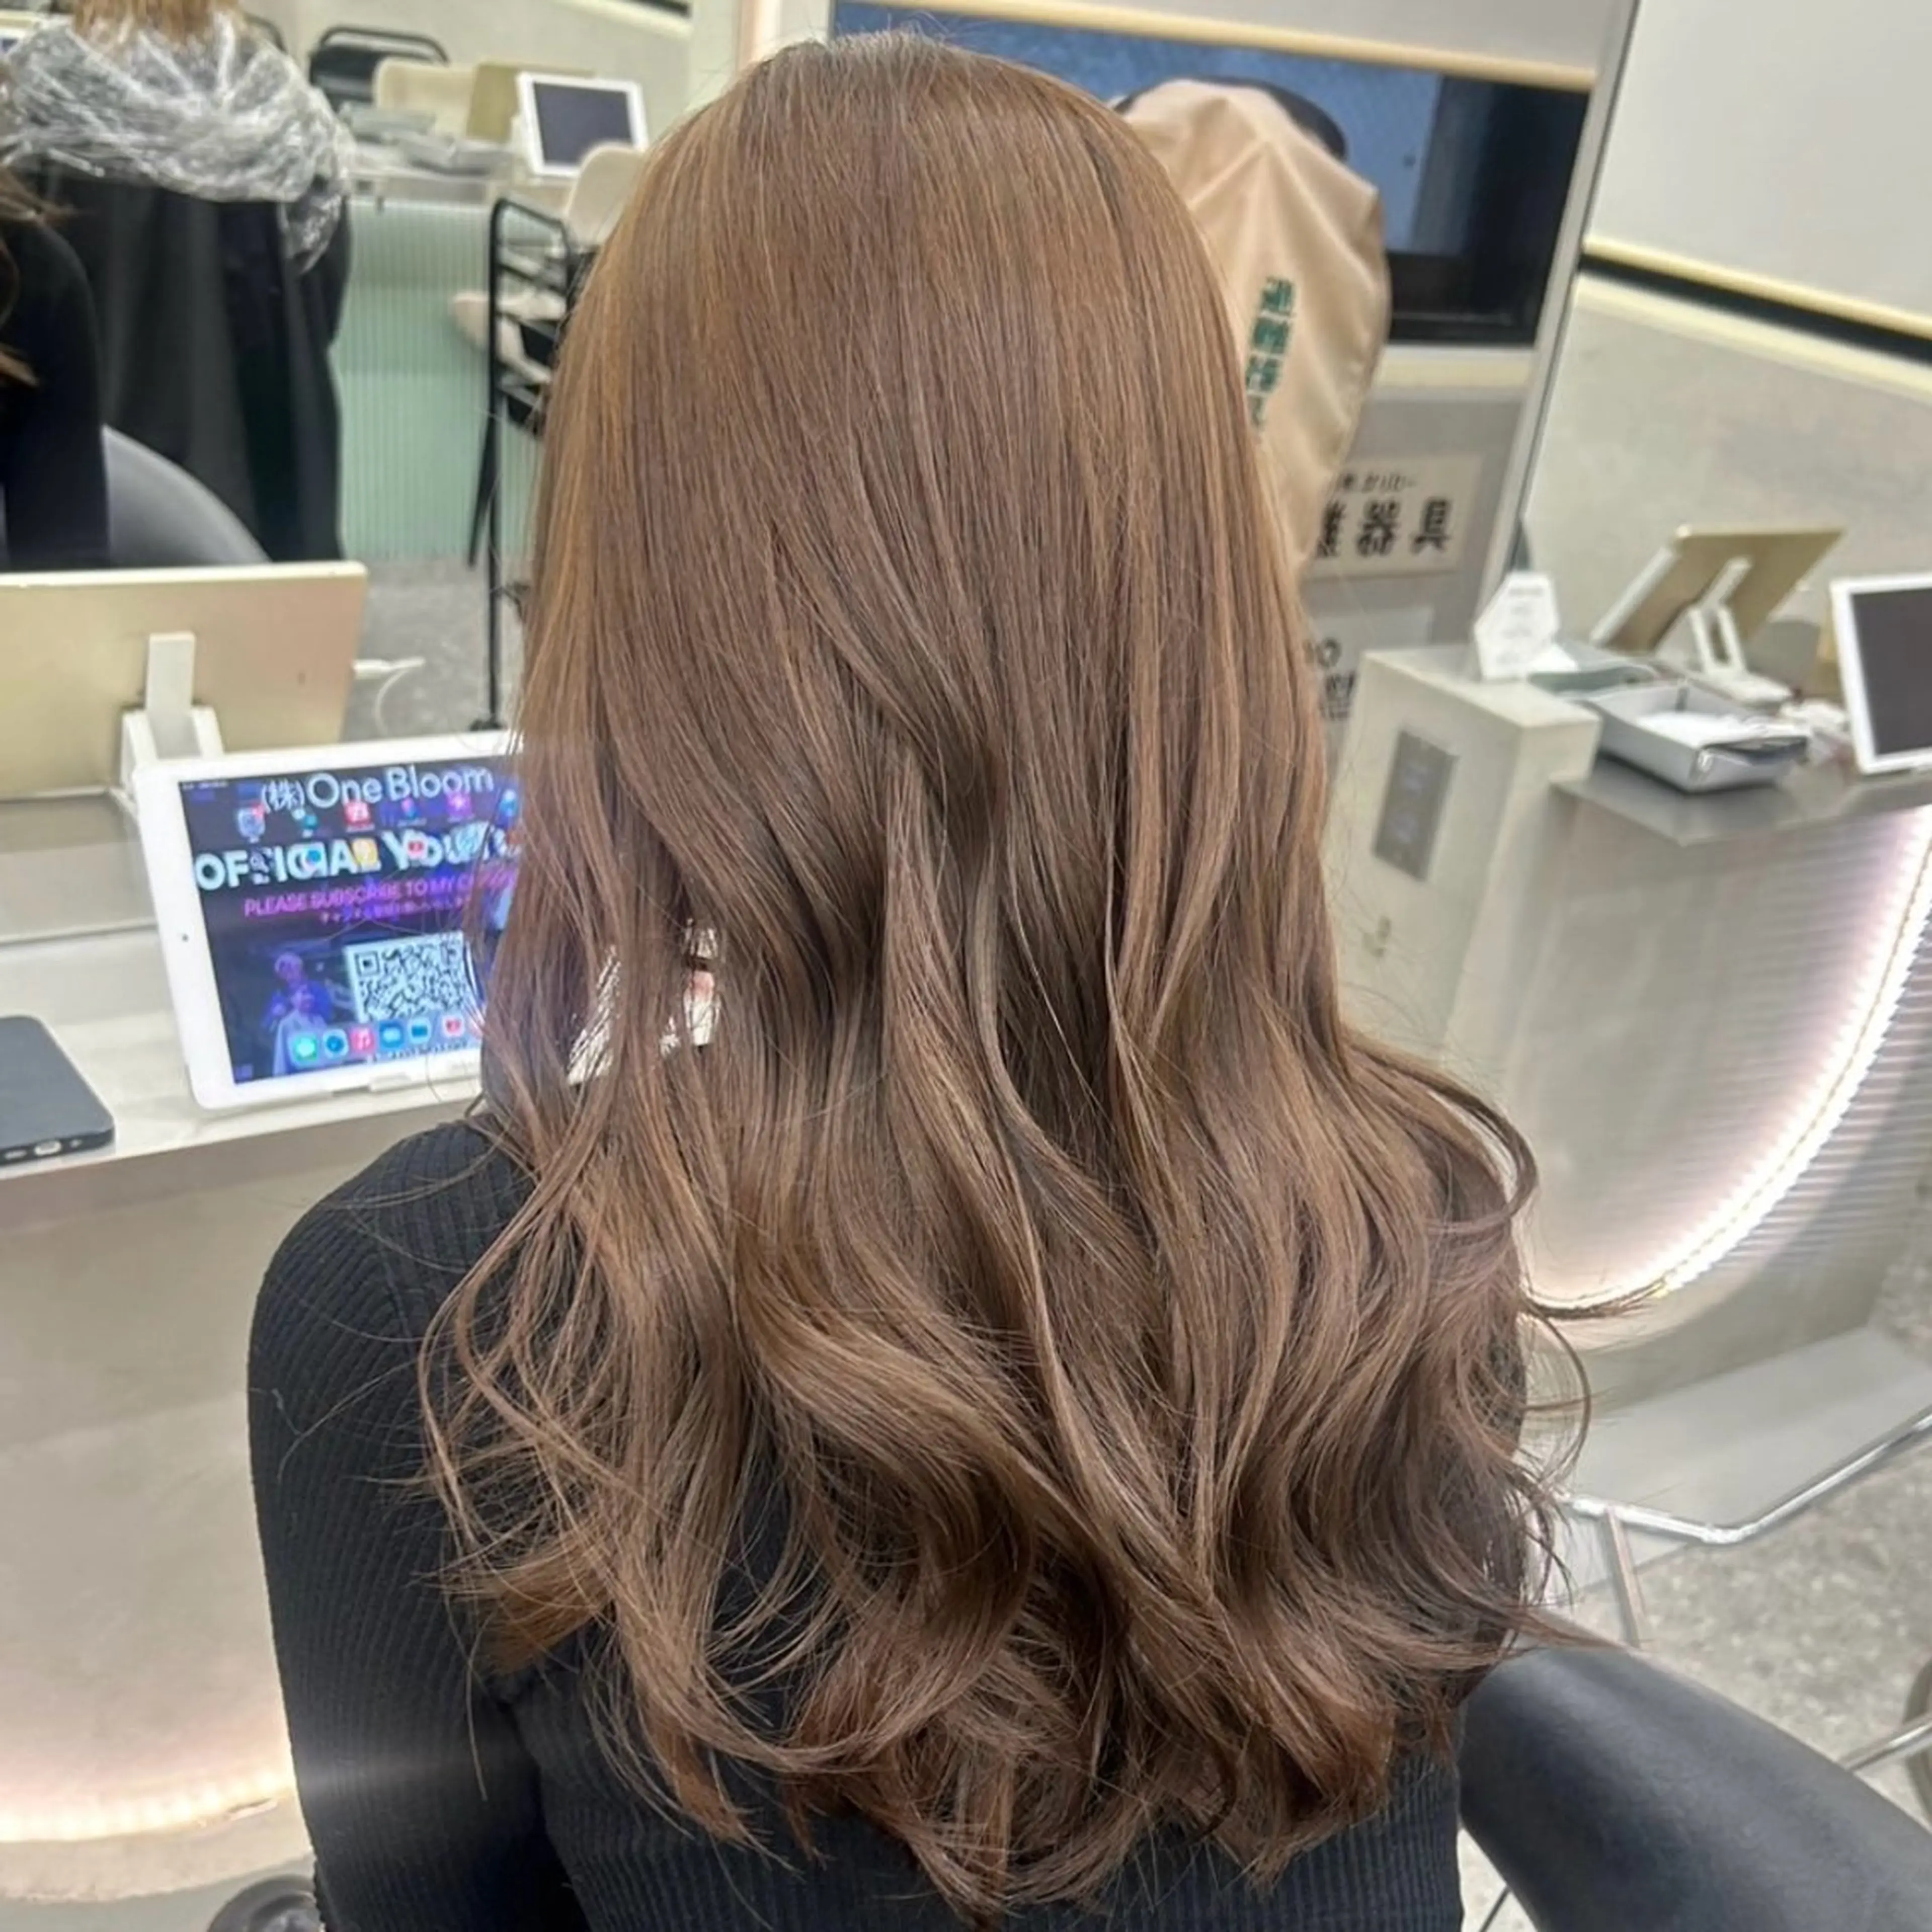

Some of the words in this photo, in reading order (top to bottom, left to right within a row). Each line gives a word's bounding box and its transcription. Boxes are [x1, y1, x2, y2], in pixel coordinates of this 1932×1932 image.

[306, 773, 382, 808] One
[385, 764, 495, 802] Bloom
[195, 837, 382, 891] OFICIAL
[244, 893, 307, 917] PLEASE
